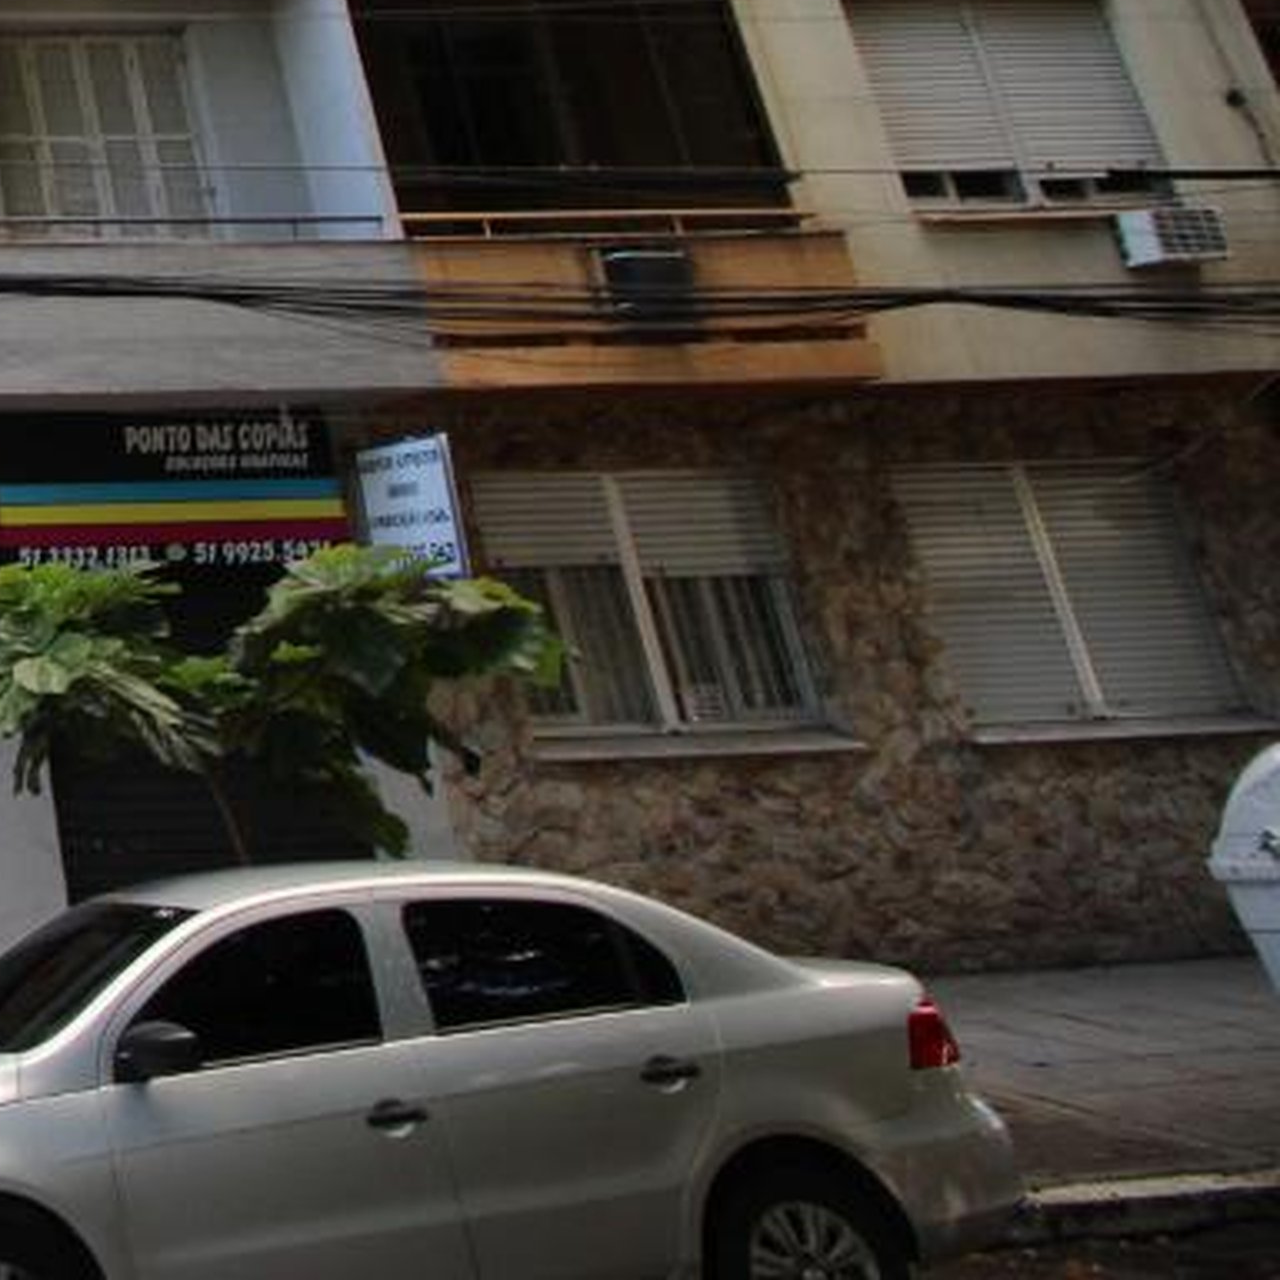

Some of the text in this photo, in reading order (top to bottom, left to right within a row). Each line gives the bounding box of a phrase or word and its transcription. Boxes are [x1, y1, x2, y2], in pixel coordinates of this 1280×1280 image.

[124, 422, 309, 453] PONTO DAS COPIAS
[18, 546, 42, 567] 51
[193, 541, 216, 565] 51
